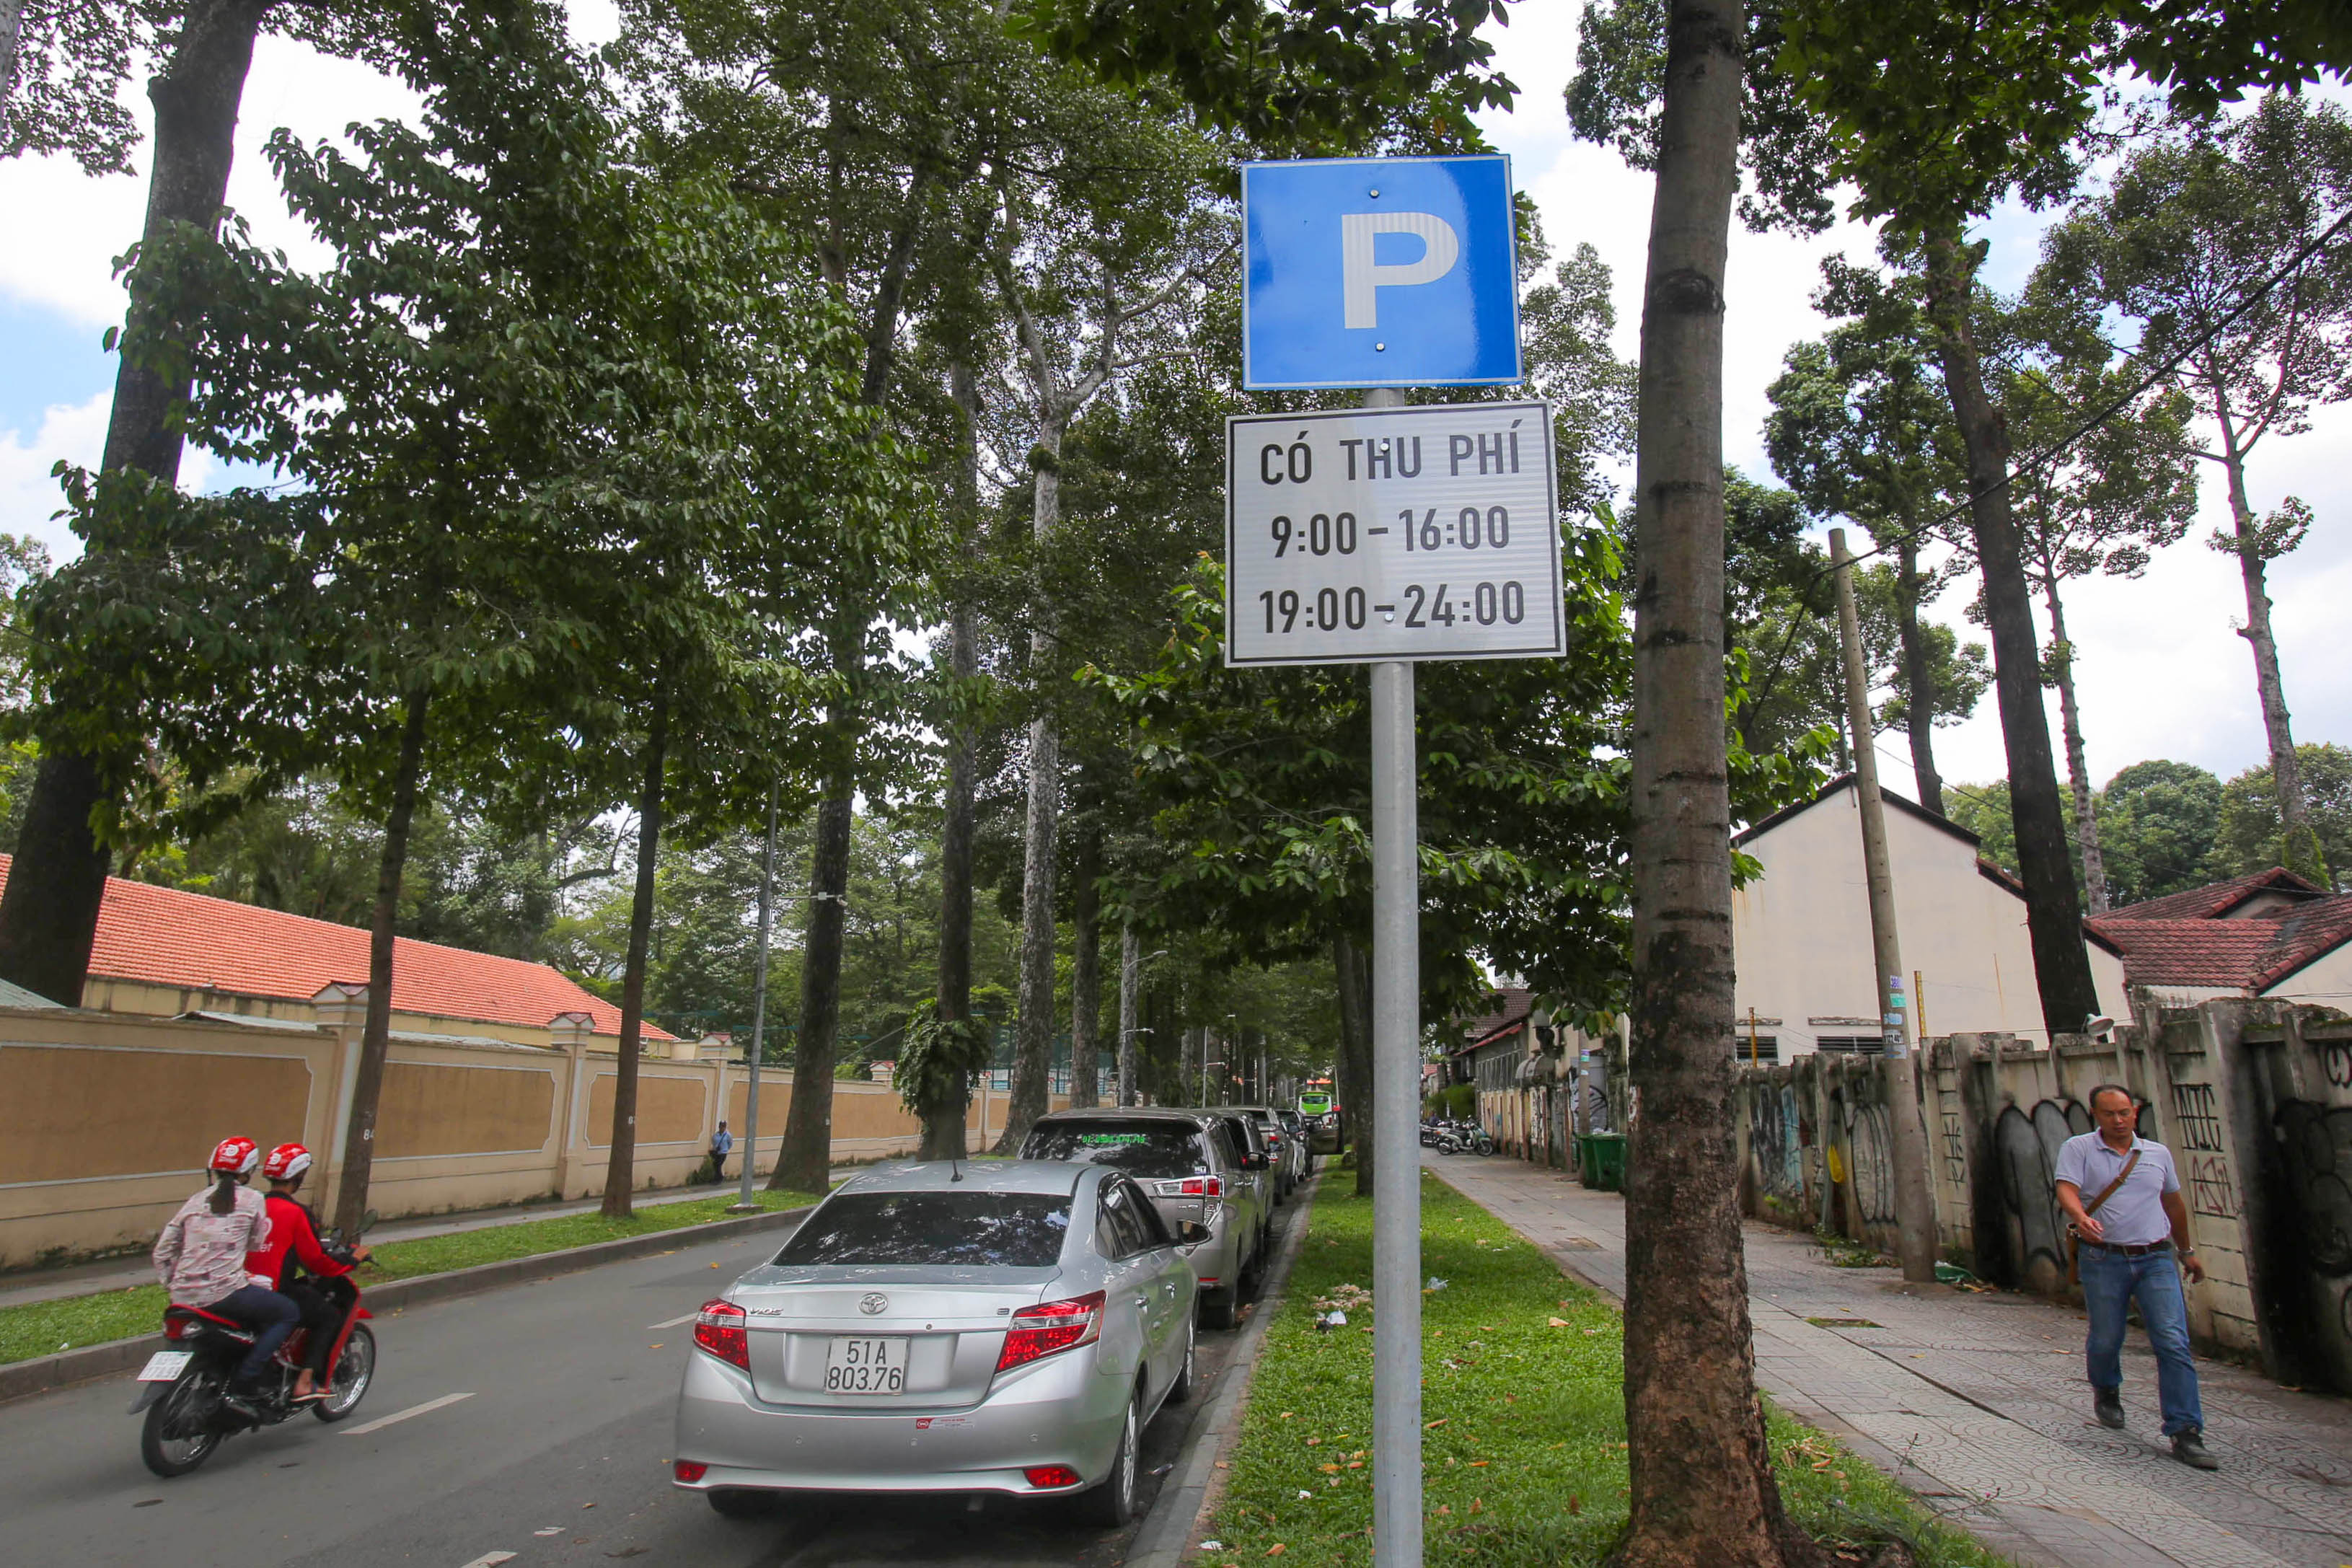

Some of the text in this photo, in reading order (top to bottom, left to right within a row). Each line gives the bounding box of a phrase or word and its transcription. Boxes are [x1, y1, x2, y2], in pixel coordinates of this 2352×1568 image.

[1342, 212, 1458, 330] P
[1261, 418, 1523, 485] CÓ THU PHÍ
[1272, 513, 1357, 558] 9:00
[1399, 506, 1510, 552] 16:00
[1259, 586, 1366, 634] 19:00
[1404, 581, 1525, 628] 24:00
[828, 1366, 902, 1391] 803.76
[847, 1341, 886, 1365] 51A
